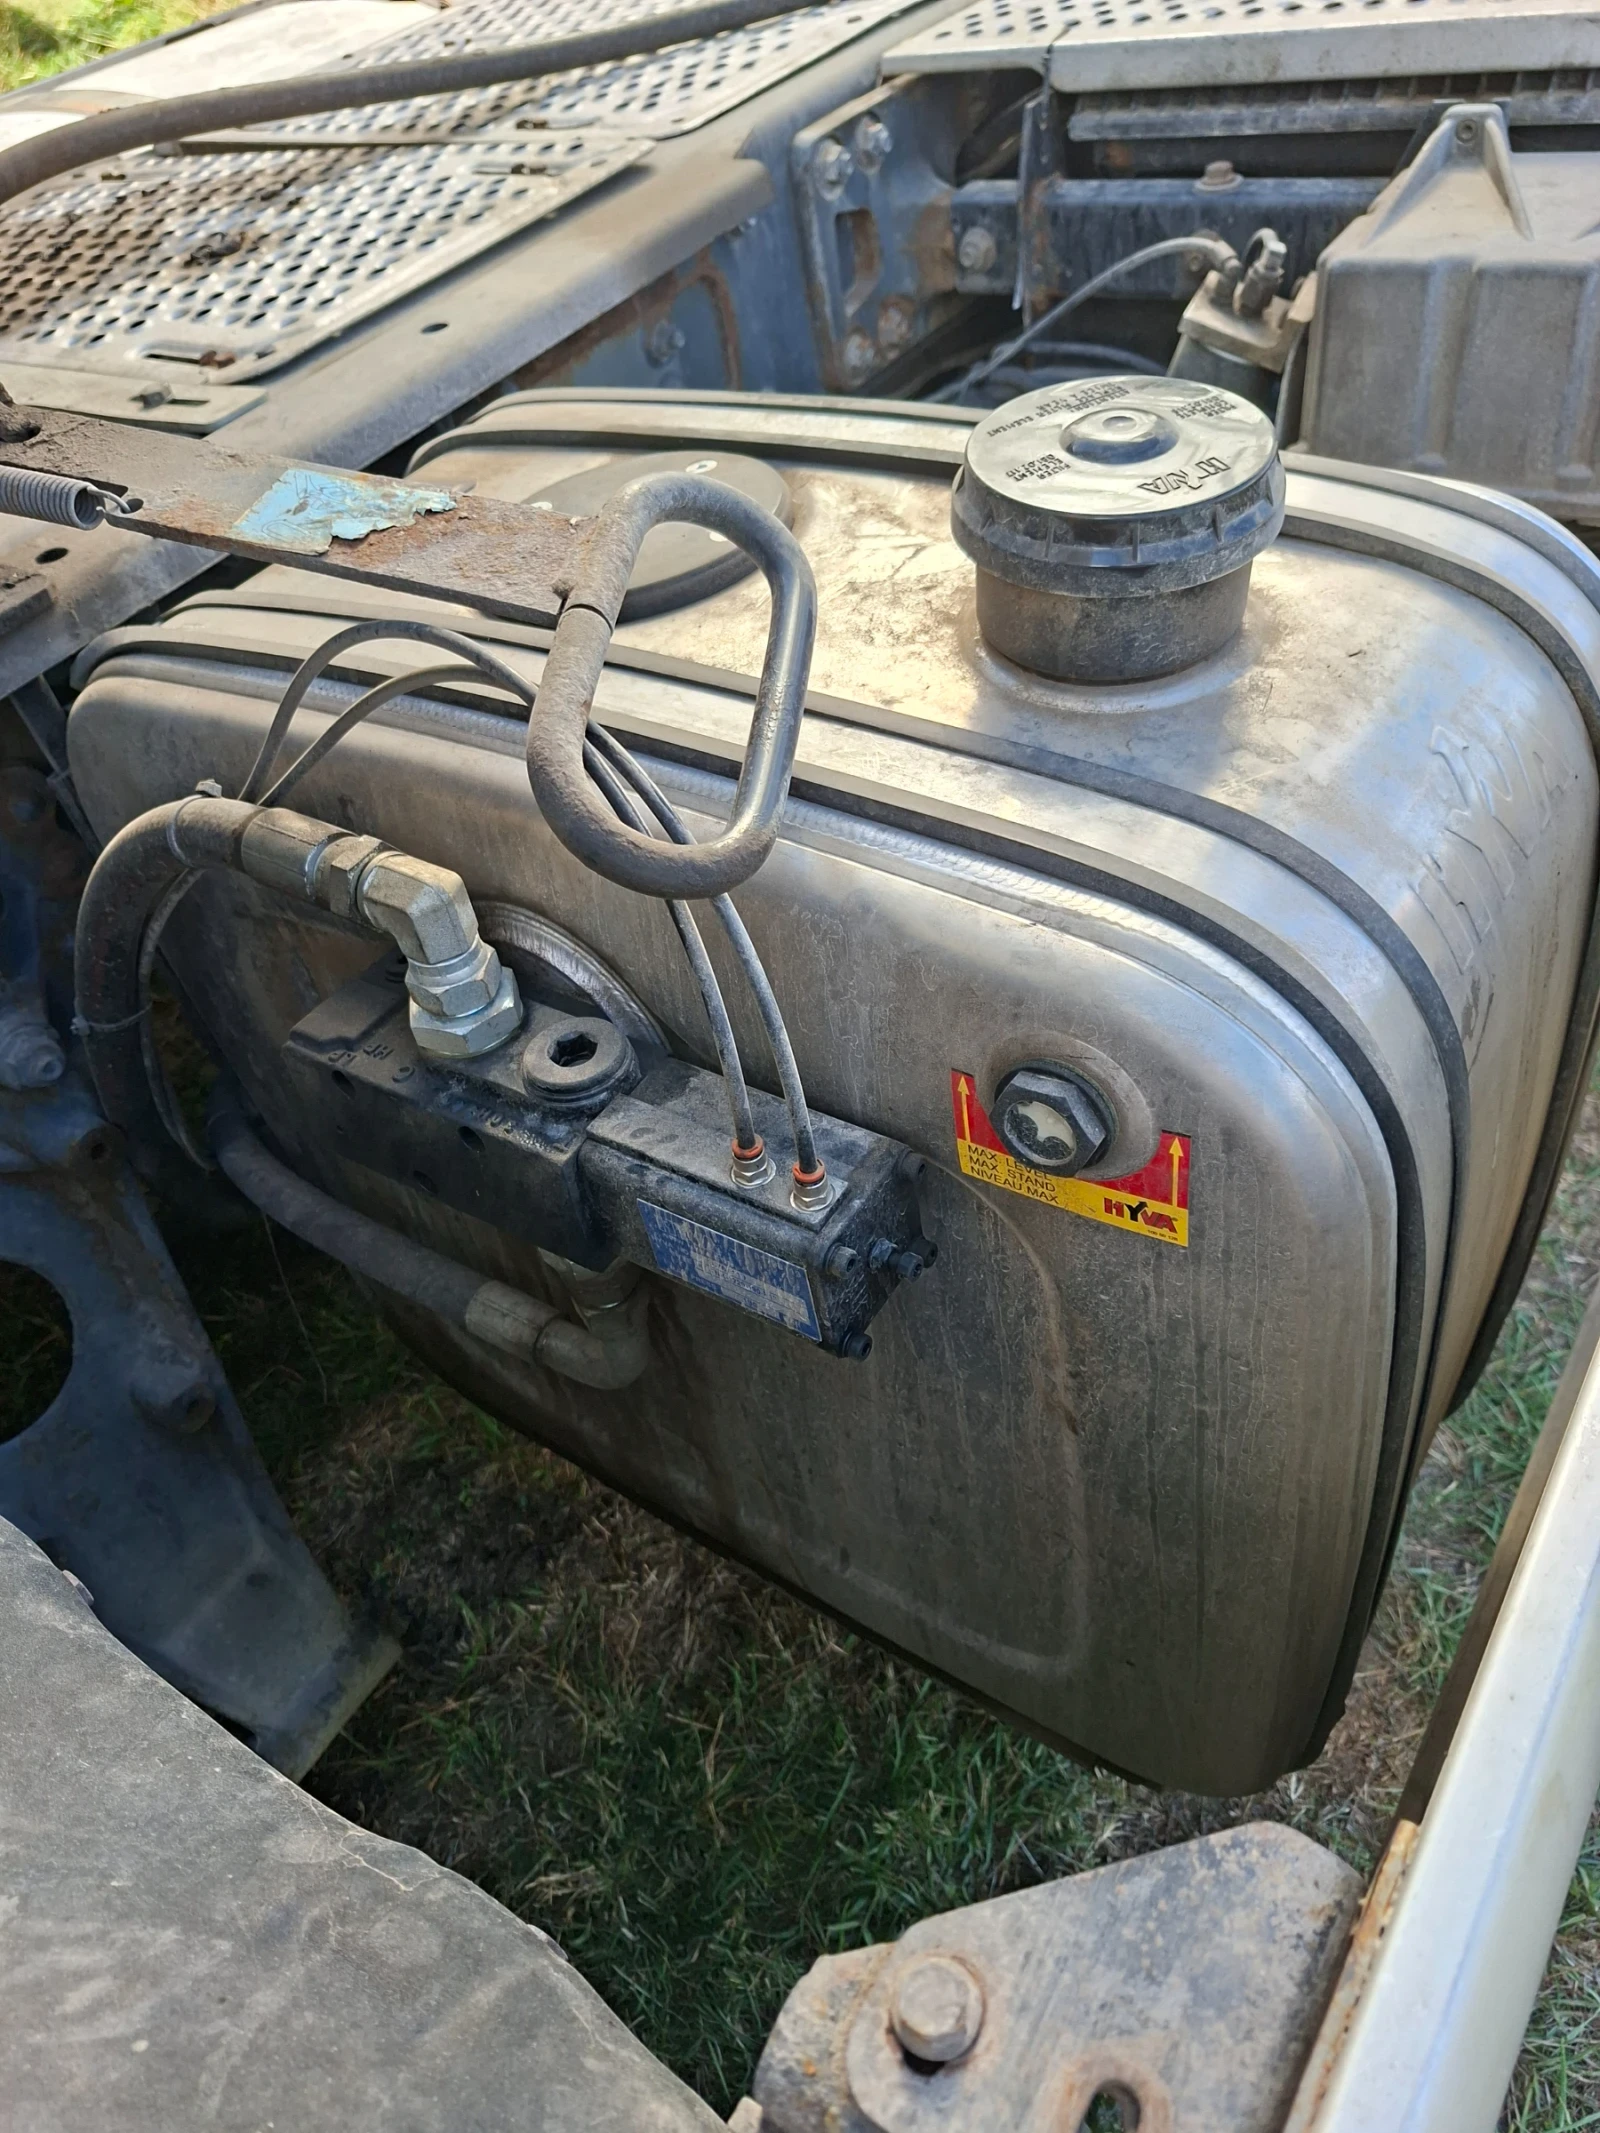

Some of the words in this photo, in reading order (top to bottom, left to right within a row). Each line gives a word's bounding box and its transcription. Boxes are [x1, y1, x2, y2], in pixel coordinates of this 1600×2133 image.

[1036, 403, 1073, 417] FILTER
[1175, 400, 1229, 419] COMPLETE
[987, 415, 1034, 437] ELEMENT
[1013, 458, 1064, 482] ELEMENT
[1036, 463, 1072, 480] FILTER
[1137, 457, 1231, 495] HYVA
[967, 1144, 1001, 1164] MAX.
[969, 1155, 1003, 1174] MAX.
[1007, 1169, 1056, 1193] STAND
[970, 1166, 1023, 1191] NIVEAU
[1027, 1186, 1059, 1205] MAX
[1104, 1197, 1178, 1234] HYVA
